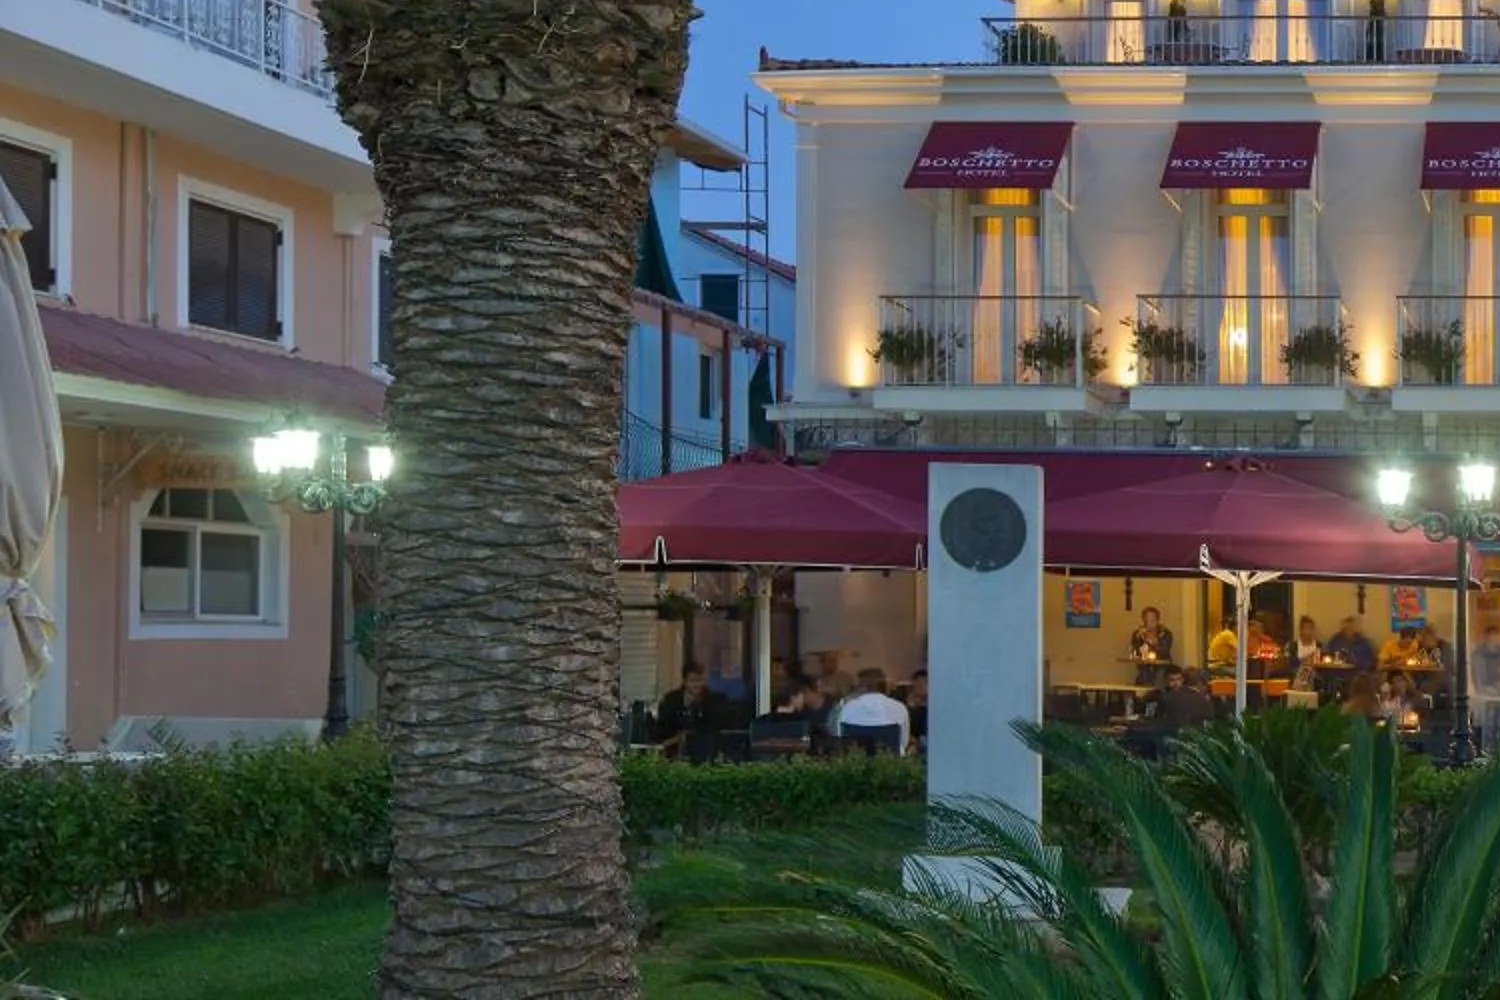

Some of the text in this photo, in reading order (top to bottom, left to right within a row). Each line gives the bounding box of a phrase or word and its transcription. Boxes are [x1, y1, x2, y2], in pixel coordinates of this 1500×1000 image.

[918, 157, 1054, 168] BOSCHETTO
[1169, 158, 1308, 169] BOSCHETTO
[956, 169, 1009, 177] HOTEL
[1211, 169, 1265, 177] HOTEL
